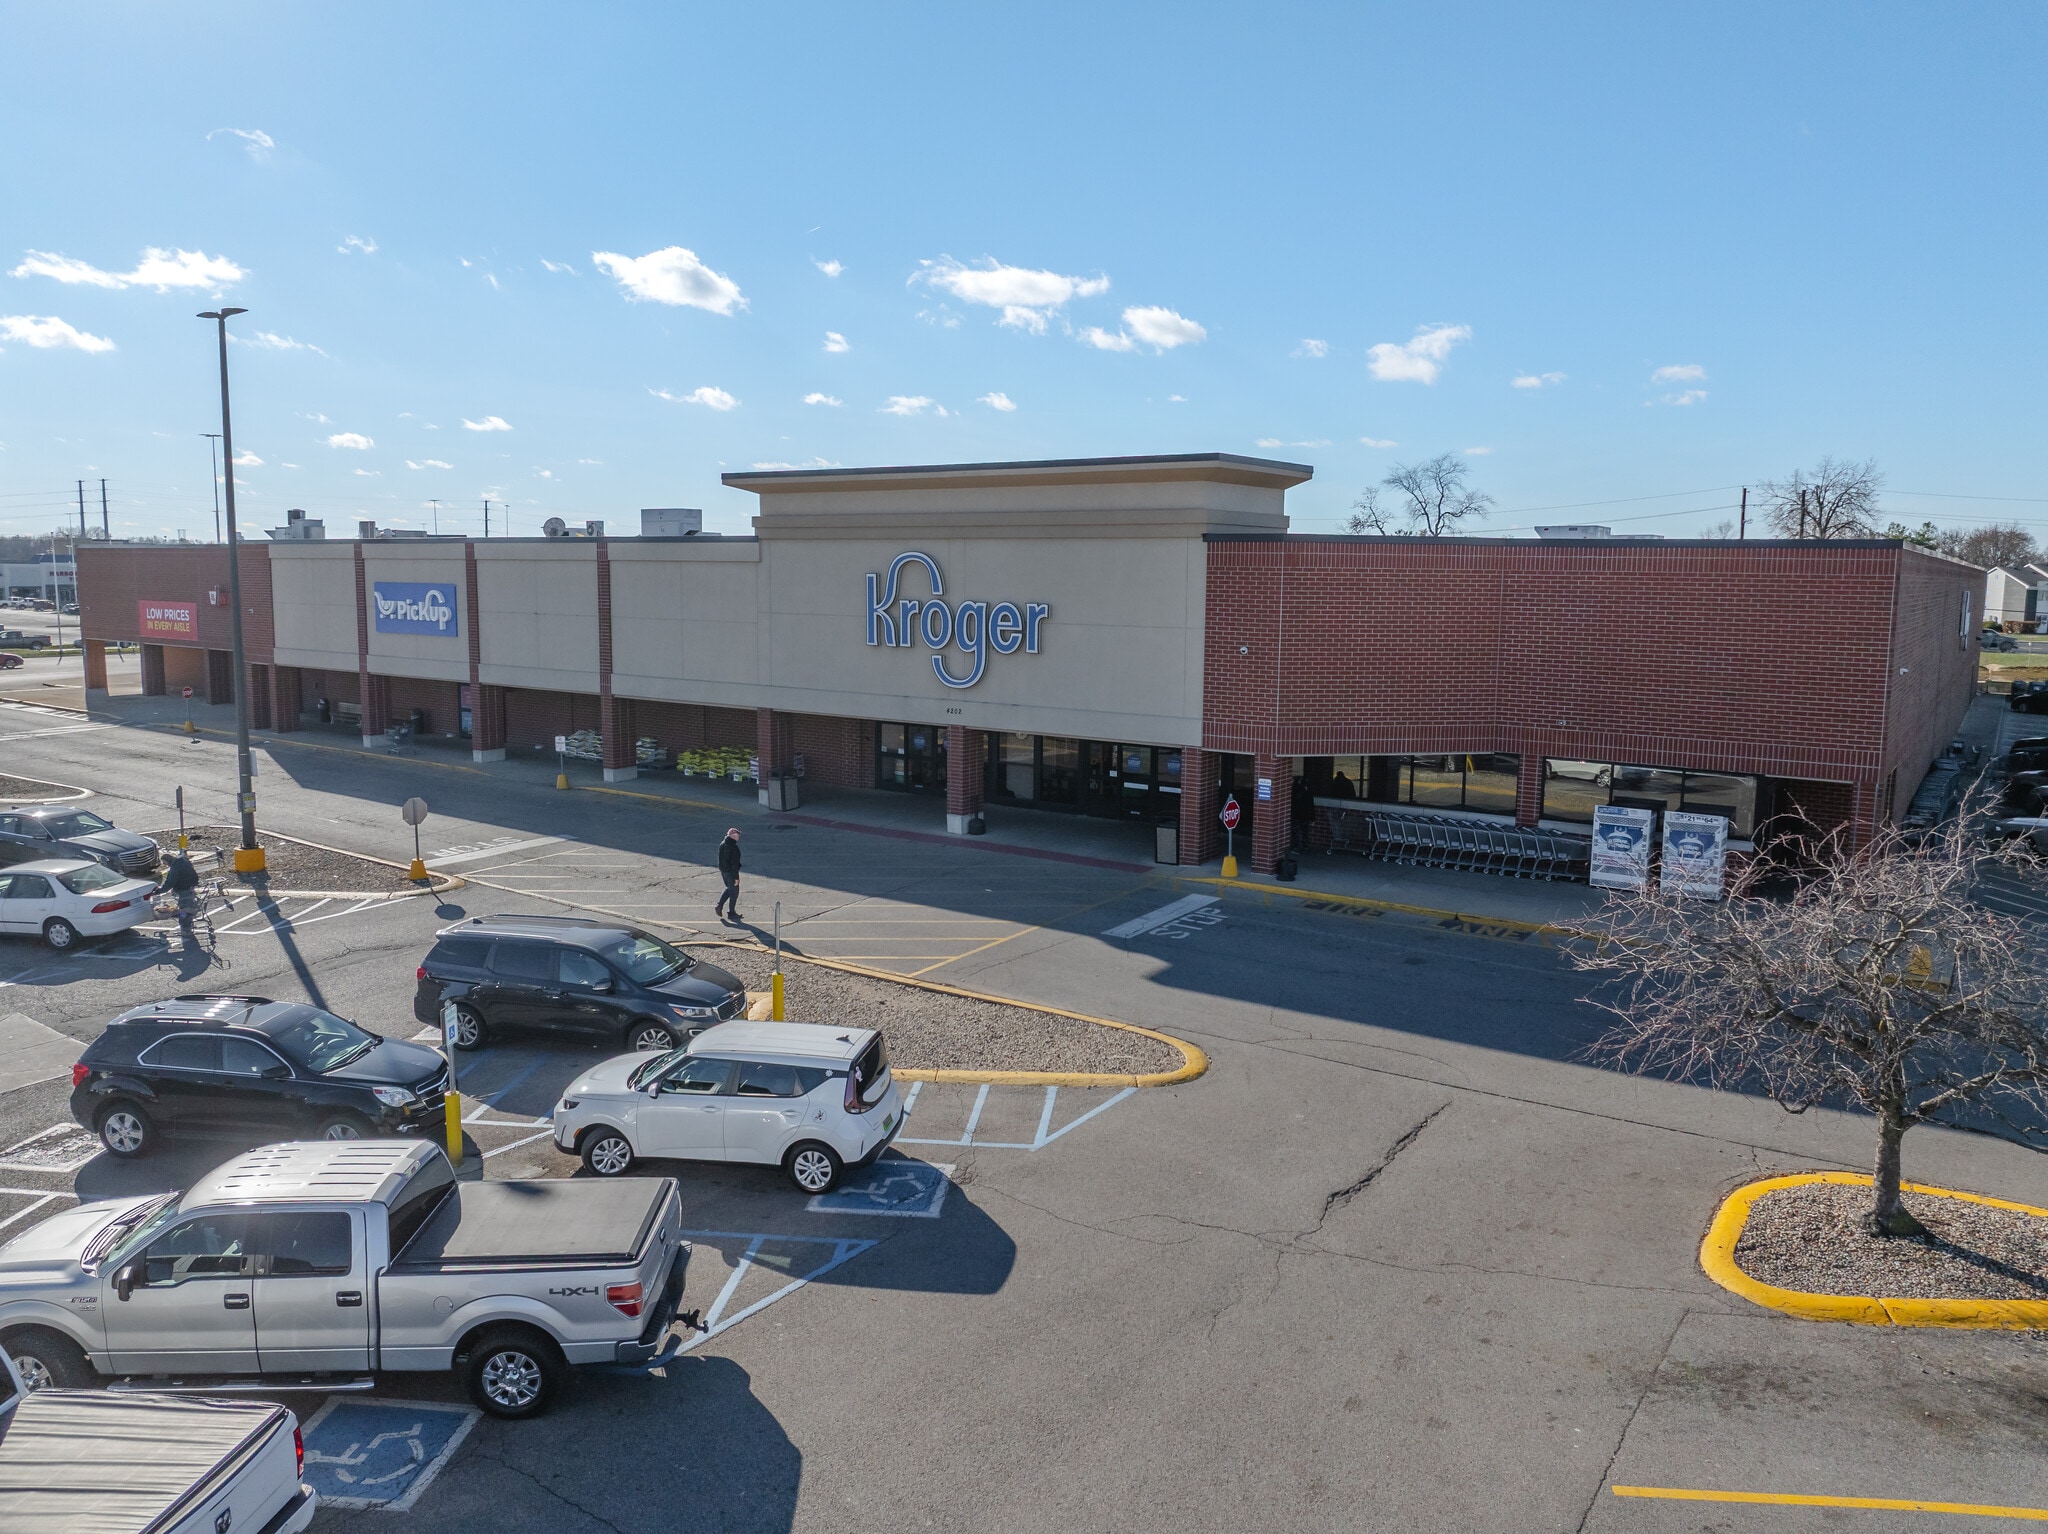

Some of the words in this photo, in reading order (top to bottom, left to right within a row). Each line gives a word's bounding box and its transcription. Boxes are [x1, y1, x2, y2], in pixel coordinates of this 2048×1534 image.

[146, 608, 163, 619] LOW
[164, 609, 190, 621] PRICES
[865, 551, 1050, 689] Kroger
[147, 621, 154, 630] IN
[154, 622, 172, 631] EVERY
[174, 622, 190, 632] AISLE
[1225, 808, 1239, 822] STOP
[1149, 907, 1229, 939] STOP
[1436, 919, 1533, 942] LANE
